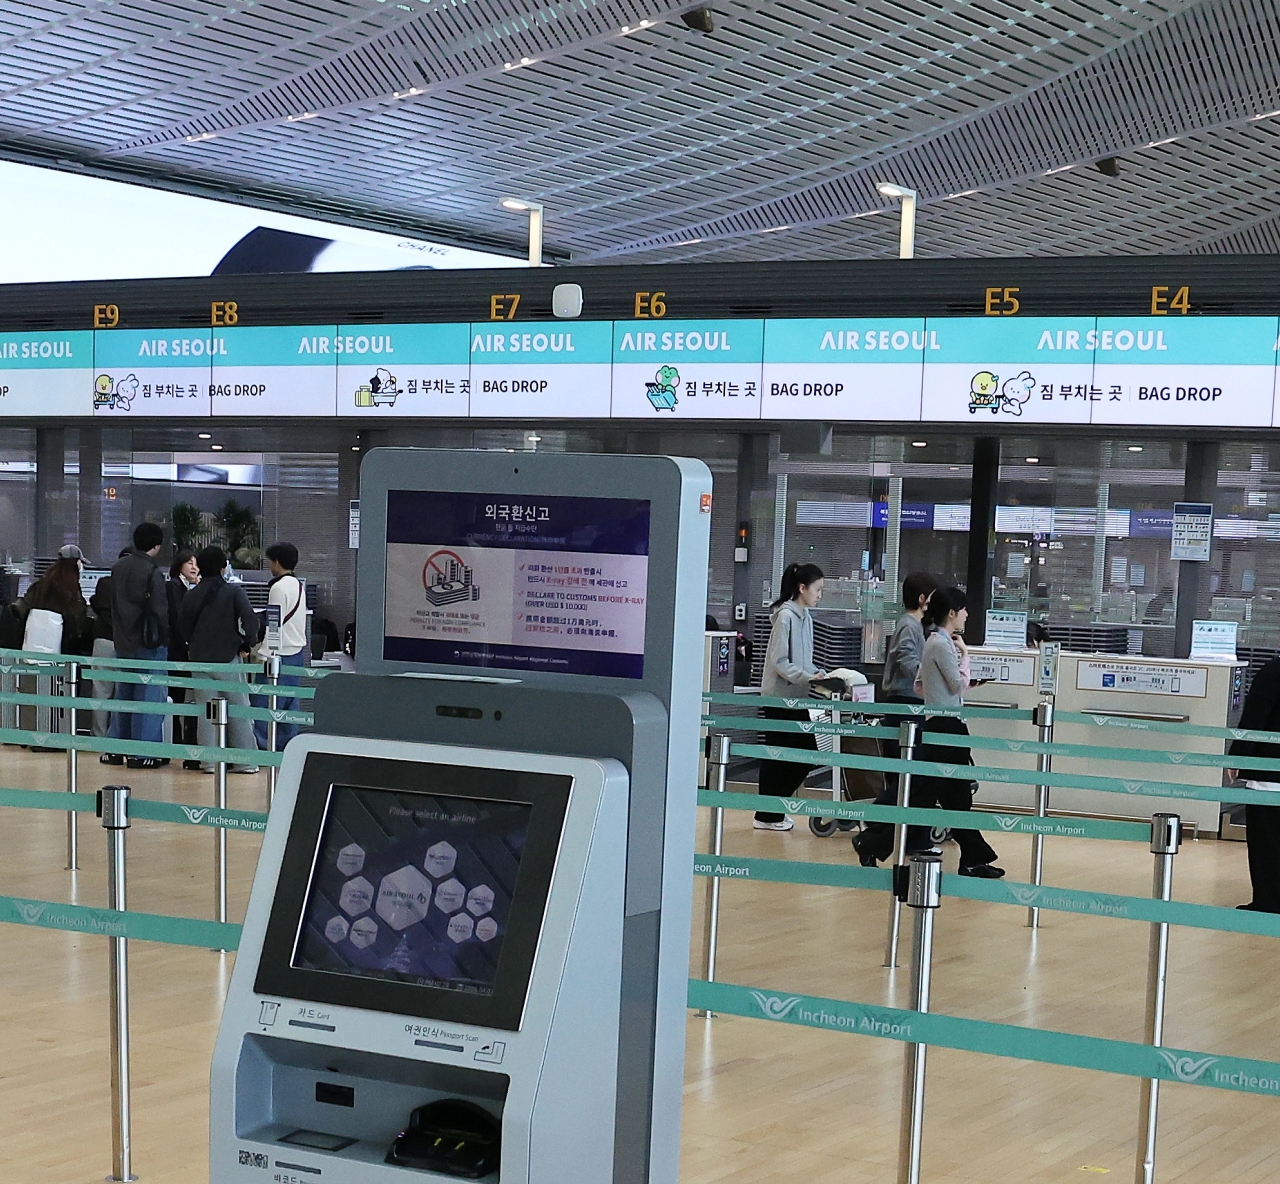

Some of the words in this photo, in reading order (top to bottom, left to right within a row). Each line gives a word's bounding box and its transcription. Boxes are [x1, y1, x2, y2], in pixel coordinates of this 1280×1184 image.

[490, 294, 520, 319] E7
[634, 292, 666, 317] E6
[985, 288, 1020, 316] E5
[1151, 286, 1191, 314] E4
[93, 305, 119, 328] E9
[211, 302, 238, 325] E8
[21, 341, 72, 359] SEOUL
[138, 340, 168, 357] AIR
[171, 338, 227, 356] SEOUL
[297, 337, 331, 354] AIR
[333, 335, 394, 354] SEOUL
[471, 334, 505, 353] AIR
[509, 333, 575, 353] SEOUL
[620, 333, 657, 351] AIR
[661, 332, 731, 351] SEOUL
[820, 331, 860, 351] AIR
[864, 331, 941, 351] SEOUL
[1036, 331, 1080, 351] AIR
[1085, 330, 1168, 351] SEOUL
[407, 380, 418, 394] 짐
[421, 380, 454, 394] 부치는
[457, 380, 470, 395] 곳
[483, 380, 510, 393] BAG
[513, 380, 548, 393] DROP
[1041, 385, 1055, 400] 짐
[1058, 385, 1103, 401] 부치는
[1109, 386, 1122, 401] 곳
[1139, 387, 1171, 401] BAG
[1175, 387, 1222, 402] DROP
[485, 504, 550, 521] 외국환신고
[799, 1008, 855, 1028] Incheon
[860, 1016, 911, 1036] Airport
[1215, 1068, 1279, 1091] Incheon
